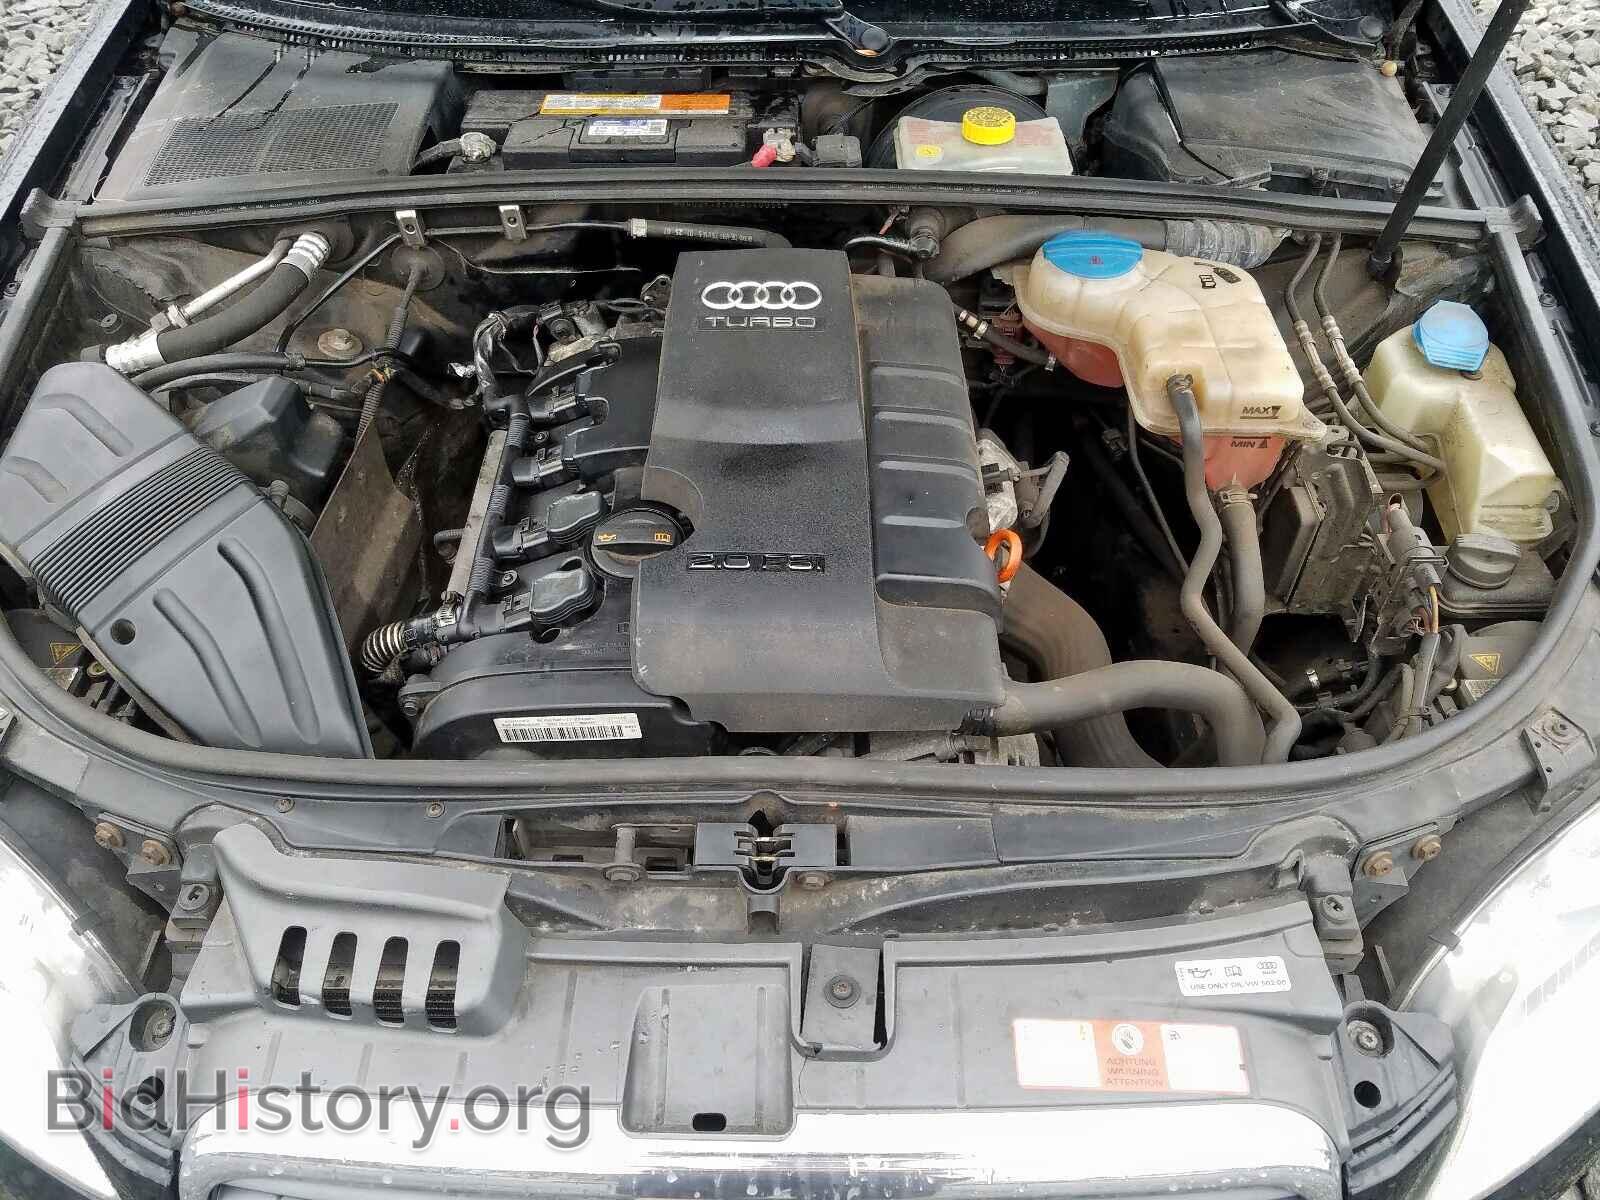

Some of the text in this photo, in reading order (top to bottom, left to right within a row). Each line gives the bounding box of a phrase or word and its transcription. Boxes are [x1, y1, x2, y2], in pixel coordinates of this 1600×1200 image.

[704, 316, 816, 328] TURBO
[1242, 406, 1271, 415] MAX
[1230, 440, 1256, 448] MIN
[687, 552, 751, 570] 2.0
[1105, 1077, 1163, 1087] ATTENTION
